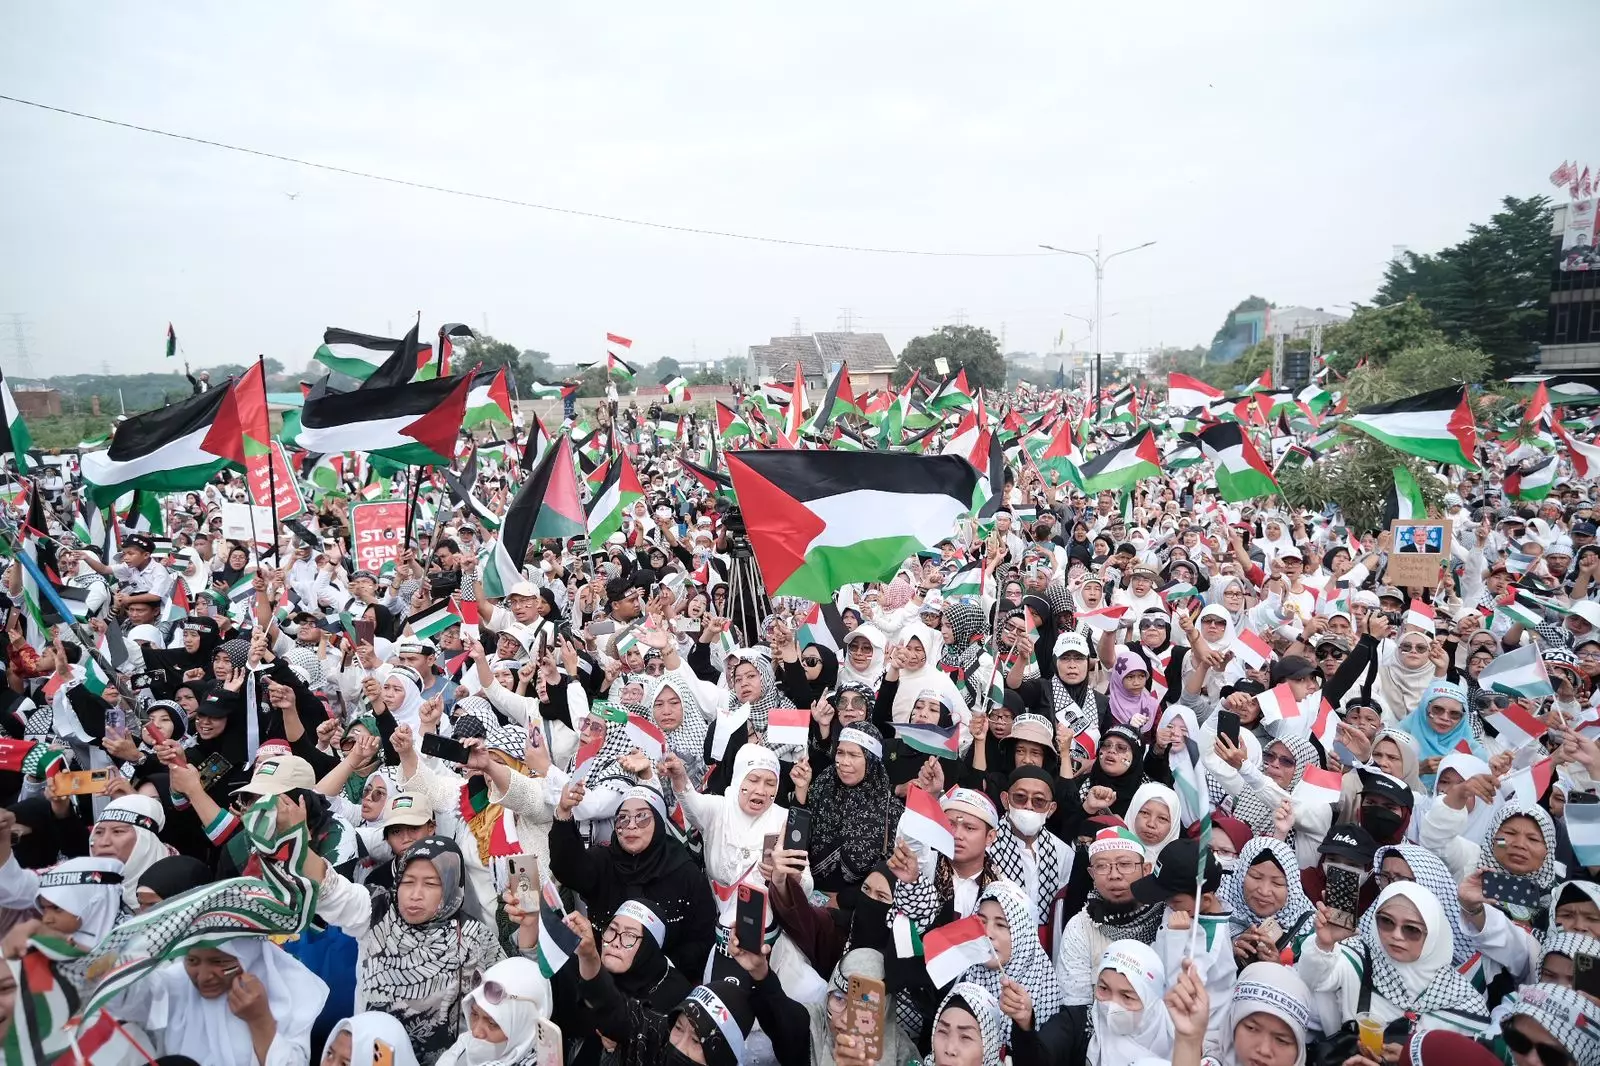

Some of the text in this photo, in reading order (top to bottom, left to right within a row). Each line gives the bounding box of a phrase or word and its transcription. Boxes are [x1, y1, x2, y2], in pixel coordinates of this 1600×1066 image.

[362, 545, 397, 559] GEN
[1332, 832, 1358, 846] Inka
[41, 872, 82, 886] ALESTINE
[1241, 987, 1307, 1021] SAVE PALESTINA
